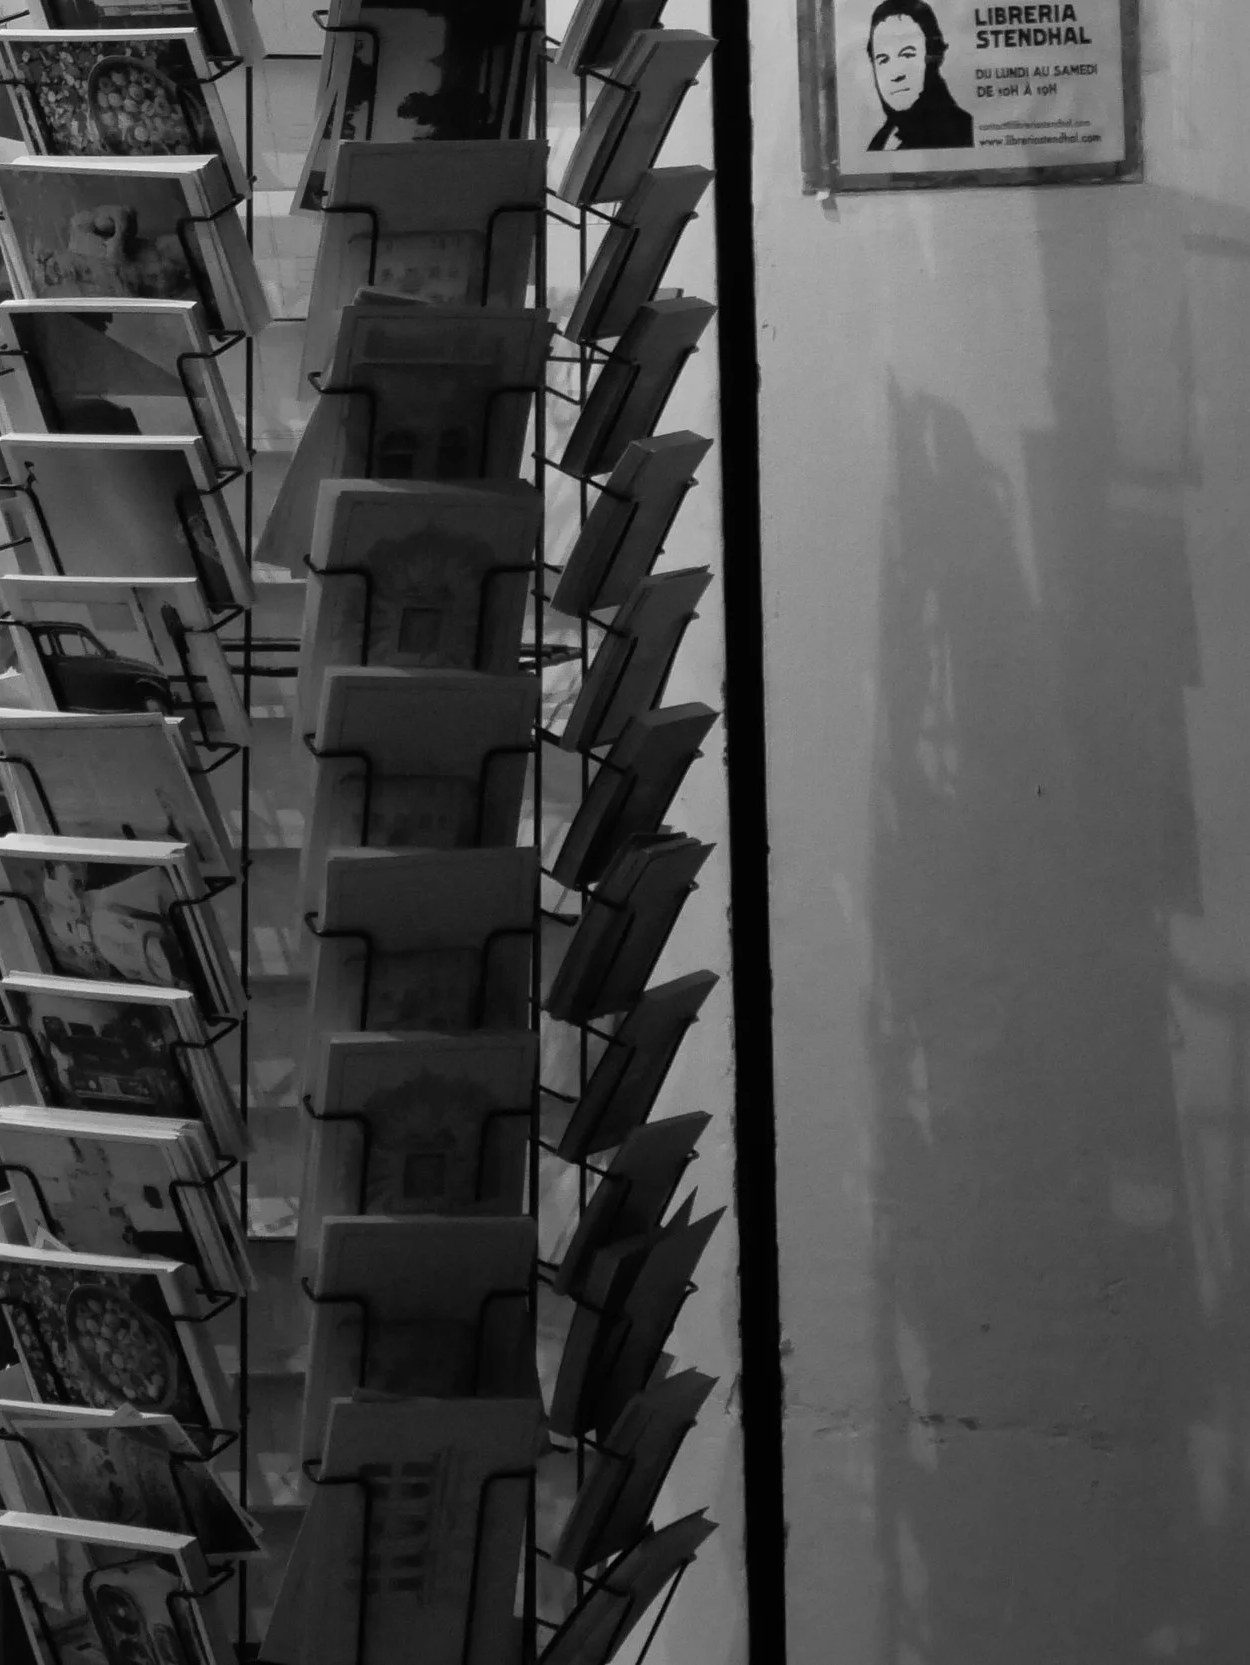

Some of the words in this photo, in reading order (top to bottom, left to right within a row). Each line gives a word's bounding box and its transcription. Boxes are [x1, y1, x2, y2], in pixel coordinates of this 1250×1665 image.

[974, 4, 1078, 27] LIBRERIA
[976, 26, 1093, 49] STENDHAL
[974, 68, 992, 80] DU
[995, 66, 1030, 79] LUNDI
[1033, 65, 1051, 78] AU
[1053, 63, 1098, 77] SAMEDI
[976, 86, 995, 98] DE
